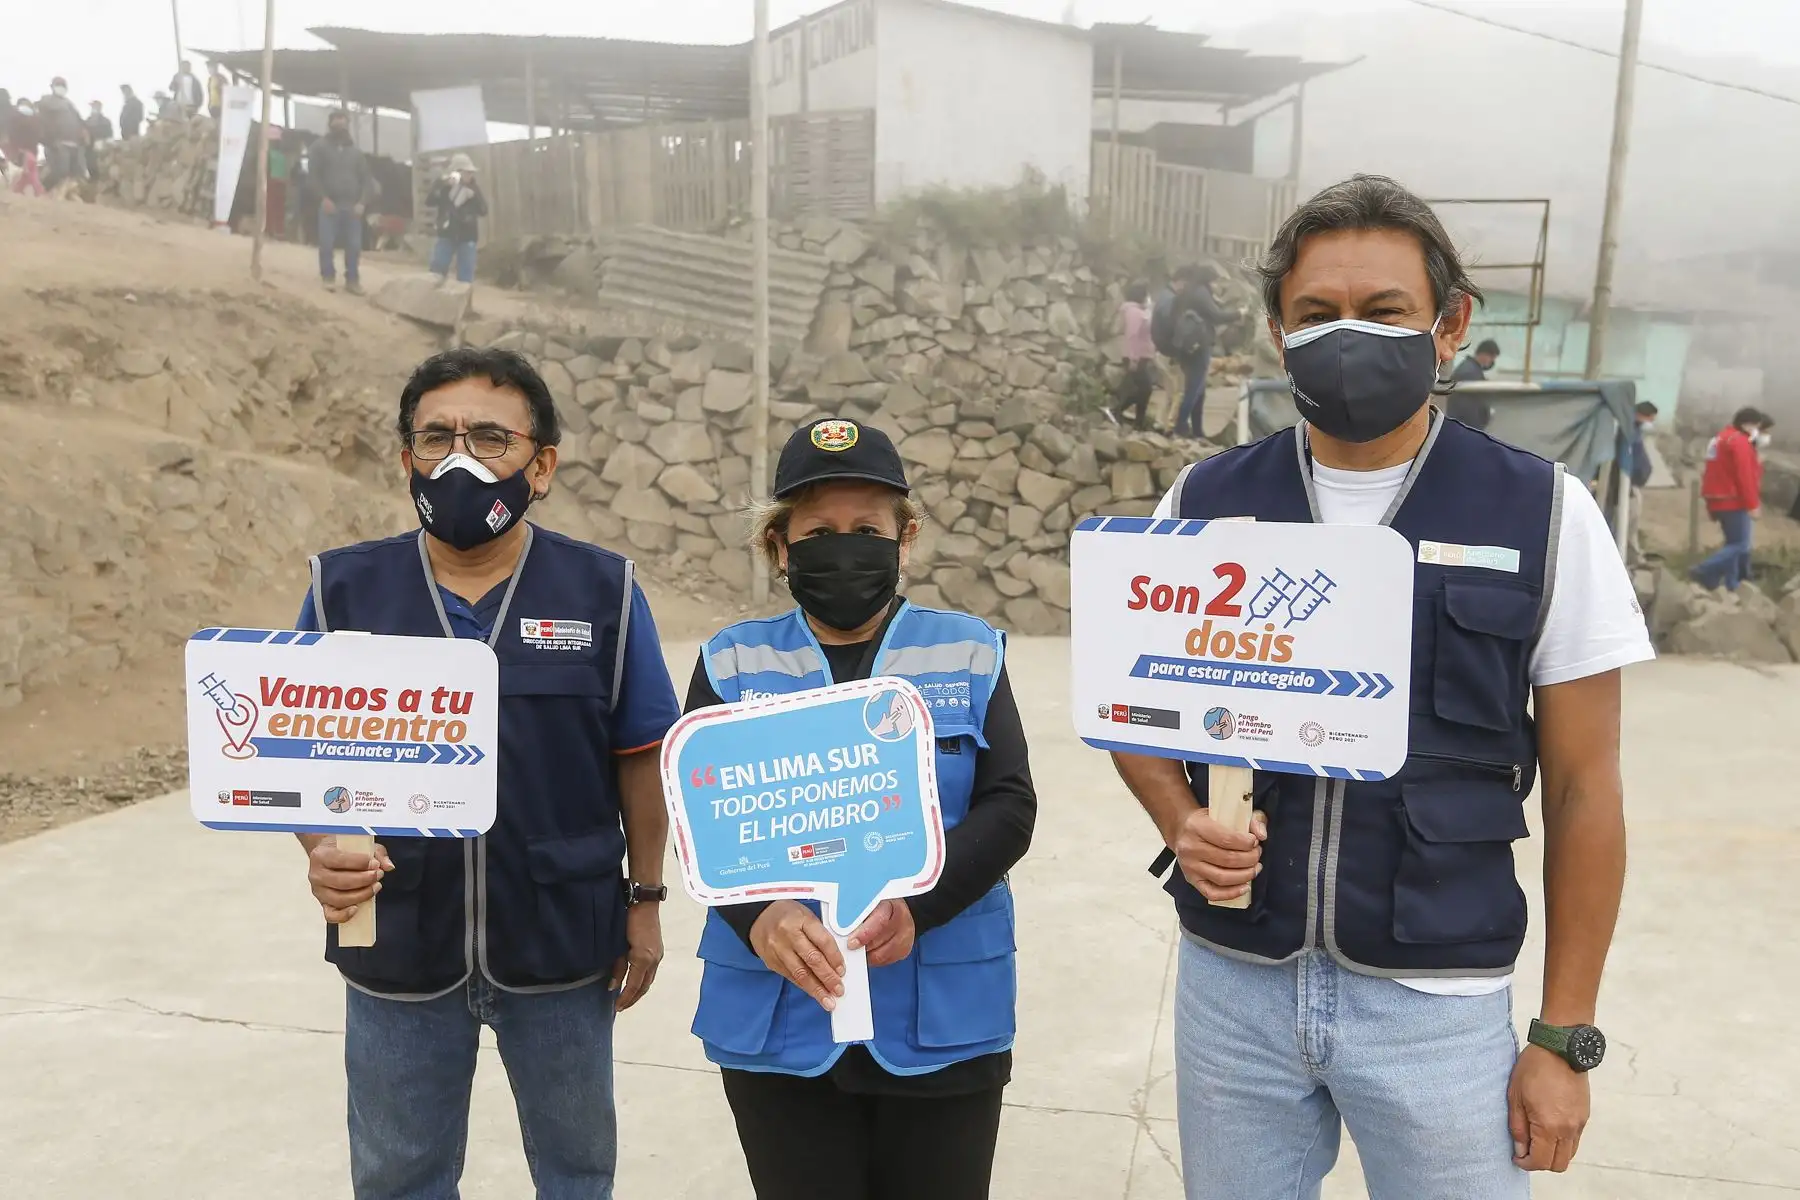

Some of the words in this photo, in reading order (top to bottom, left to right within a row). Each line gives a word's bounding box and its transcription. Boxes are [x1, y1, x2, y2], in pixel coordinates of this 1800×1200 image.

[1127, 575, 1201, 615] Son
[1204, 562, 1247, 618] 2
[1185, 620, 1295, 664] dosis
[1148, 661, 1184, 678] para
[1187, 665, 1230, 682] estar
[1231, 666, 1315, 690] protegido
[259, 676, 389, 711] Vamos
[397, 690, 423, 714] a
[431, 687, 474, 715] tu
[936, 687, 970, 696] TODOS
[267, 713, 468, 744] encuentro
[1238, 713, 1259, 721] Pongo
[1245, 721, 1272, 729] hombro
[1257, 728, 1274, 736] Perú
[1329, 731, 1369, 739] BICENTENARIO
[310, 742, 392, 760] ¡Vacúnate
[393, 746, 421, 763] ya!
[759, 752, 825, 784] LIMA
[827, 743, 880, 770] SUR
[710, 789, 787, 820] TODOS
[791, 769, 898, 805] PONEMOS
[738, 819, 766, 845] EL
